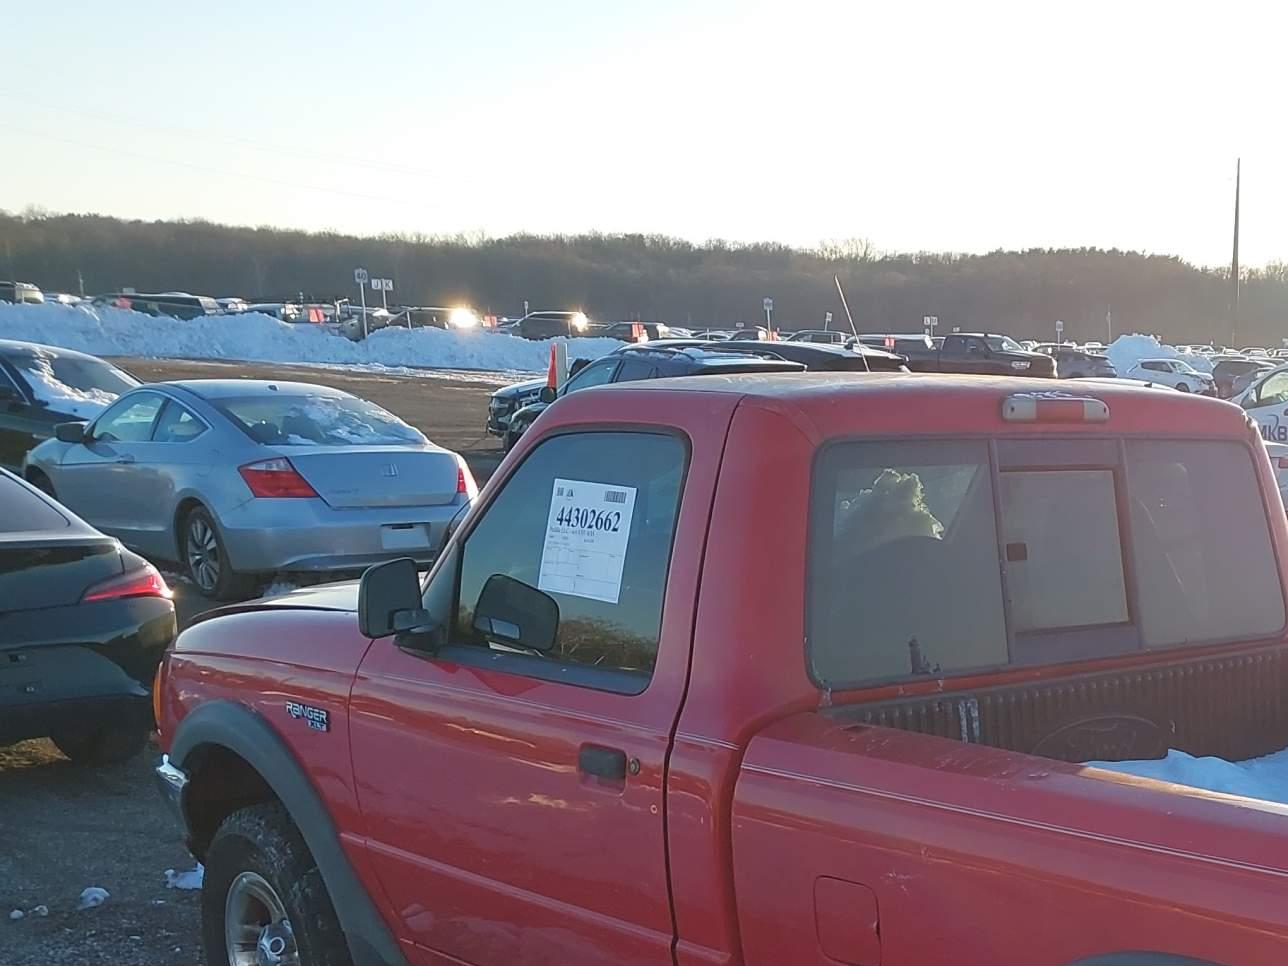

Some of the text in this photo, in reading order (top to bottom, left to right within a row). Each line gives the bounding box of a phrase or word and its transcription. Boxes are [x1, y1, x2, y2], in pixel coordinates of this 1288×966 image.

[556, 506, 621, 532] 44302662
[286, 701, 327, 723] RANGER
[310, 720, 325, 731] XLT
